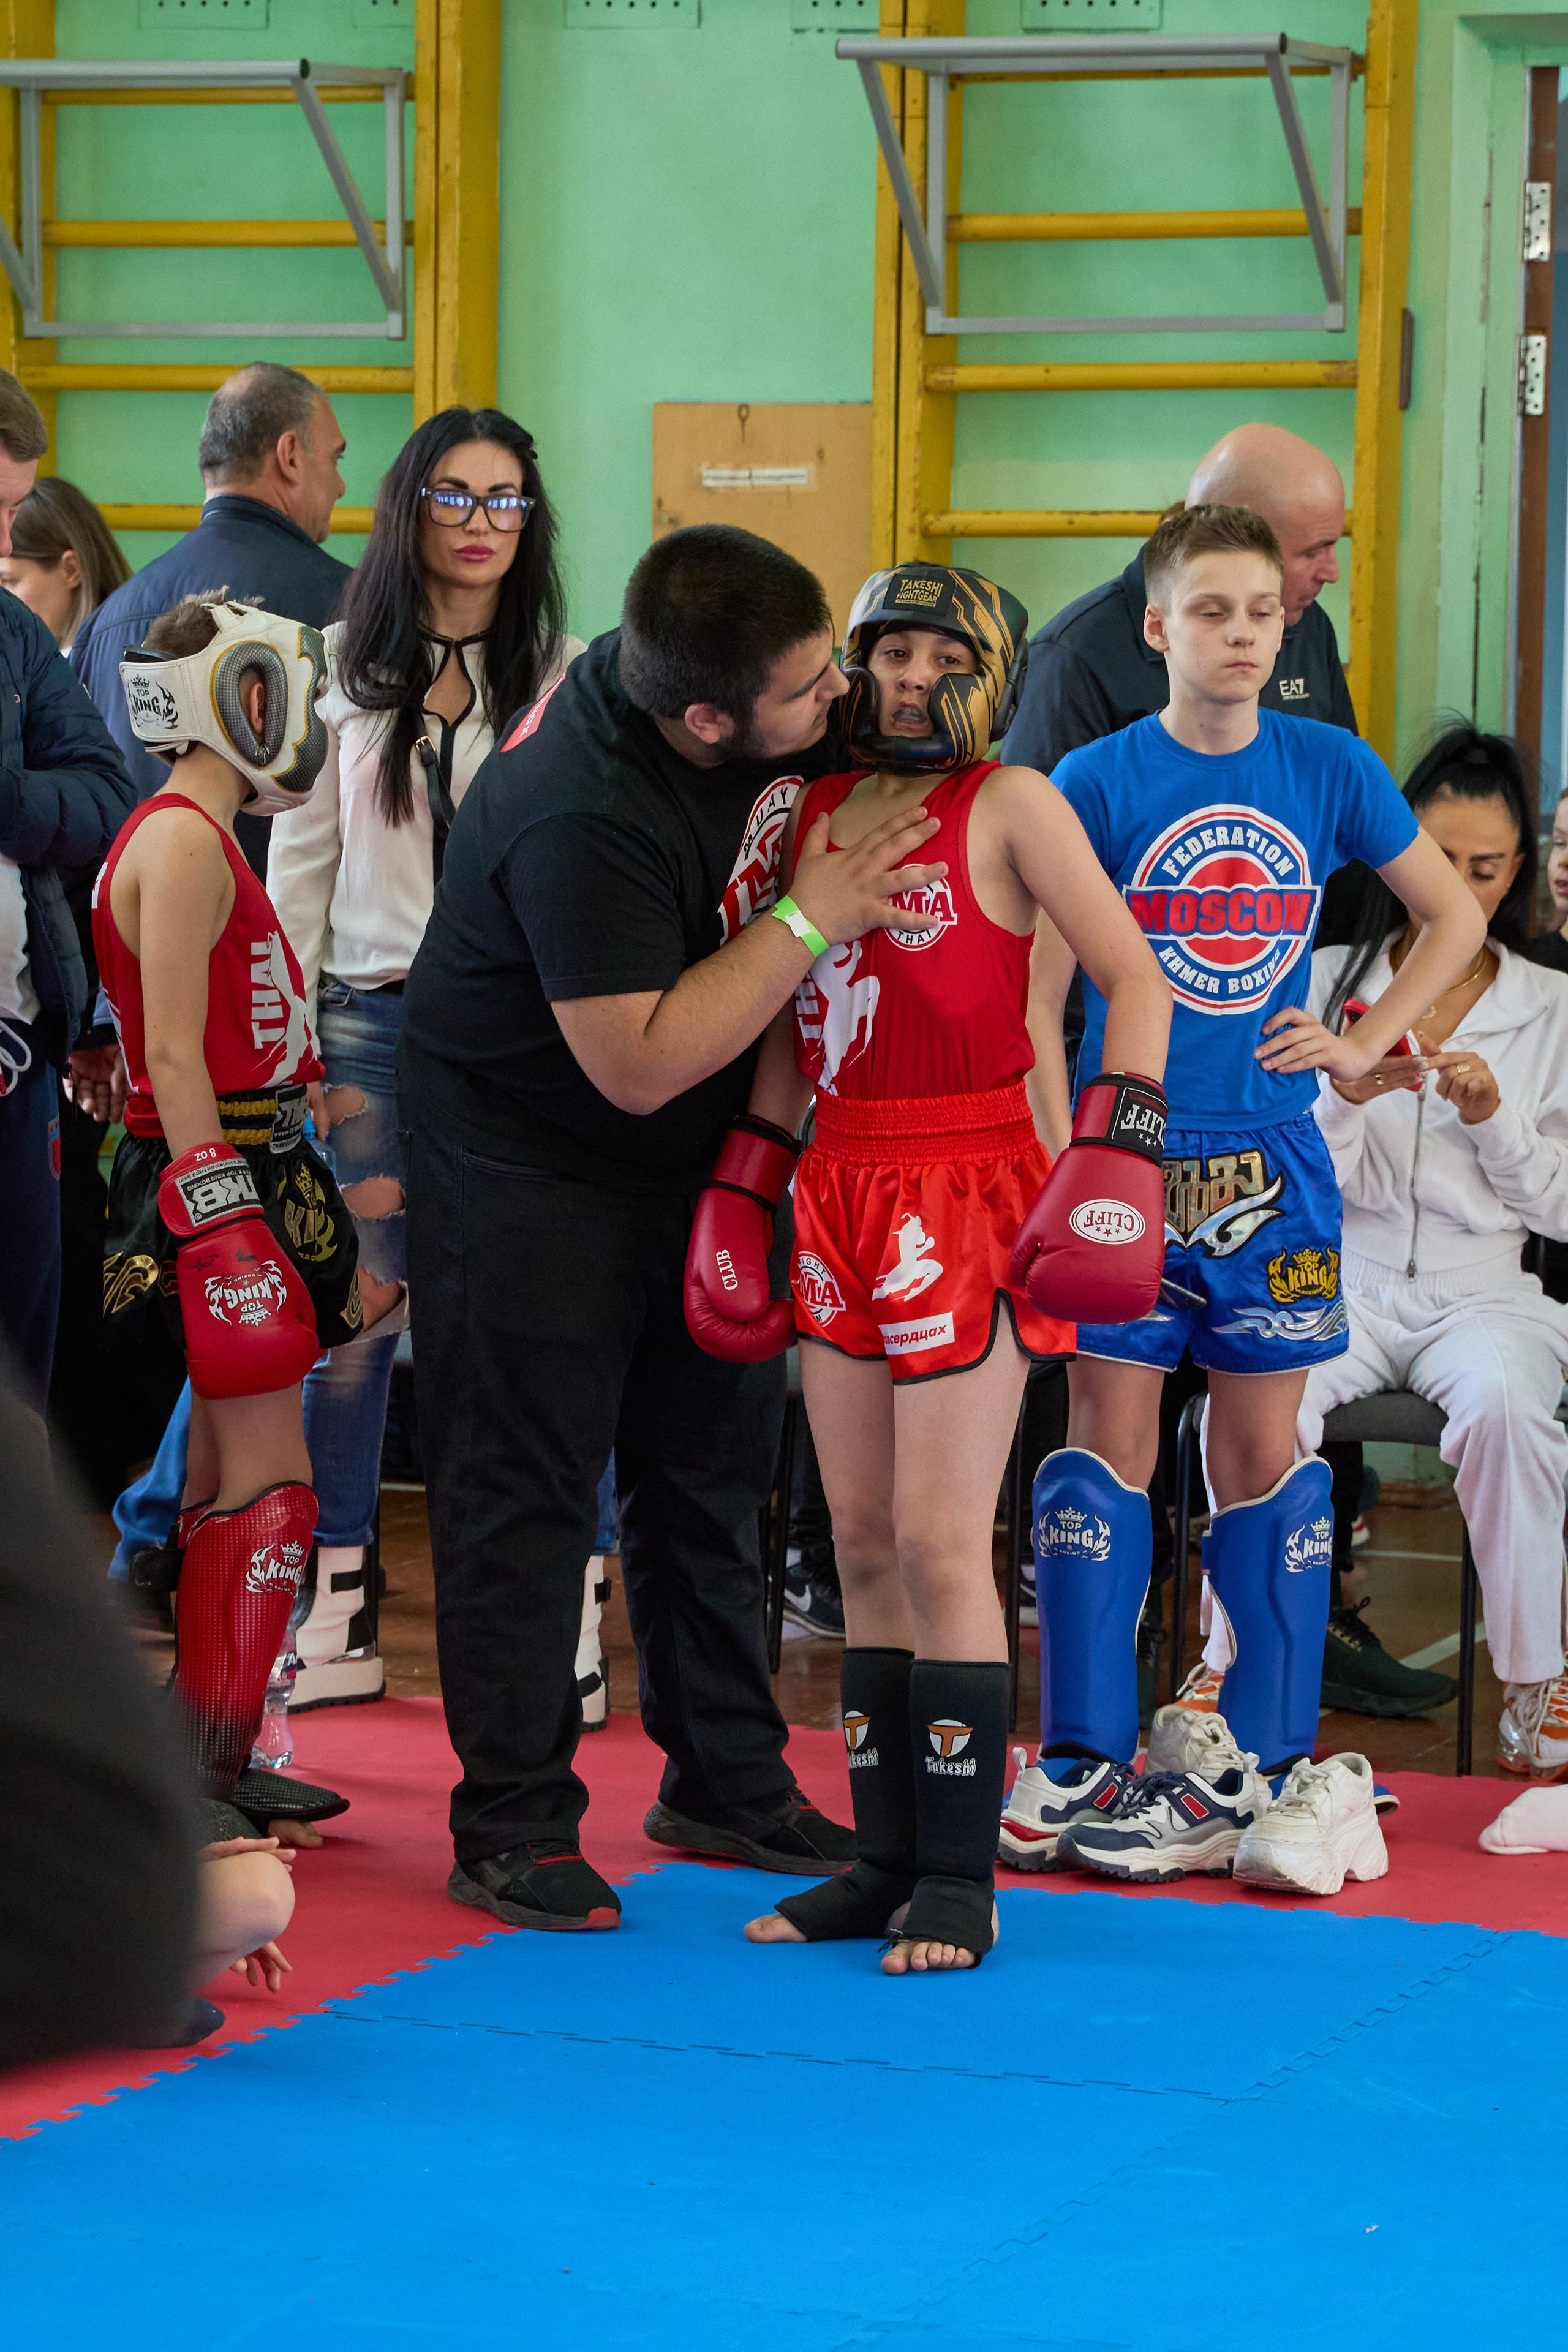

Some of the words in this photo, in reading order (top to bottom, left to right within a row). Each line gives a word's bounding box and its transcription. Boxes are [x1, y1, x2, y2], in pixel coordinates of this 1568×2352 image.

[896, 589, 938, 603] FIGHTGEAR
[900, 579, 943, 597] TAKESHI
[1279, 678, 1305, 696] EA7
[132, 694, 162, 716] KING
[743, 787, 788, 860] MUAY
[1161, 826, 1294, 878] FEDERATION
[1129, 892, 1311, 933] MOSCOW
[897, 930, 932, 944] THAI
[1158, 946, 1221, 994] KHMER
[1227, 948, 1281, 994] BOXING
[1120, 1104, 1166, 1142] LIFF
[209, 1148, 217, 1158] 8
[187, 1178, 210, 1192] BOXING
[1083, 1210, 1134, 1232] CLIFF
[715, 1250, 738, 1291] CLUB
[799, 1257, 826, 1275] IGHT
[1297, 1262, 1319, 1272] TOP
[1287, 1265, 1327, 1292] KING
[224, 1277, 273, 1309] KING
[241, 1300, 263, 1312] TOP
[1060, 1521, 1082, 1530] TOP
[1049, 1525, 1093, 1549] KING
[1314, 1531, 1329, 1540] TOP
[283, 1555, 300, 1565] TOP
[925, 1755, 976, 1776] Takeshi
